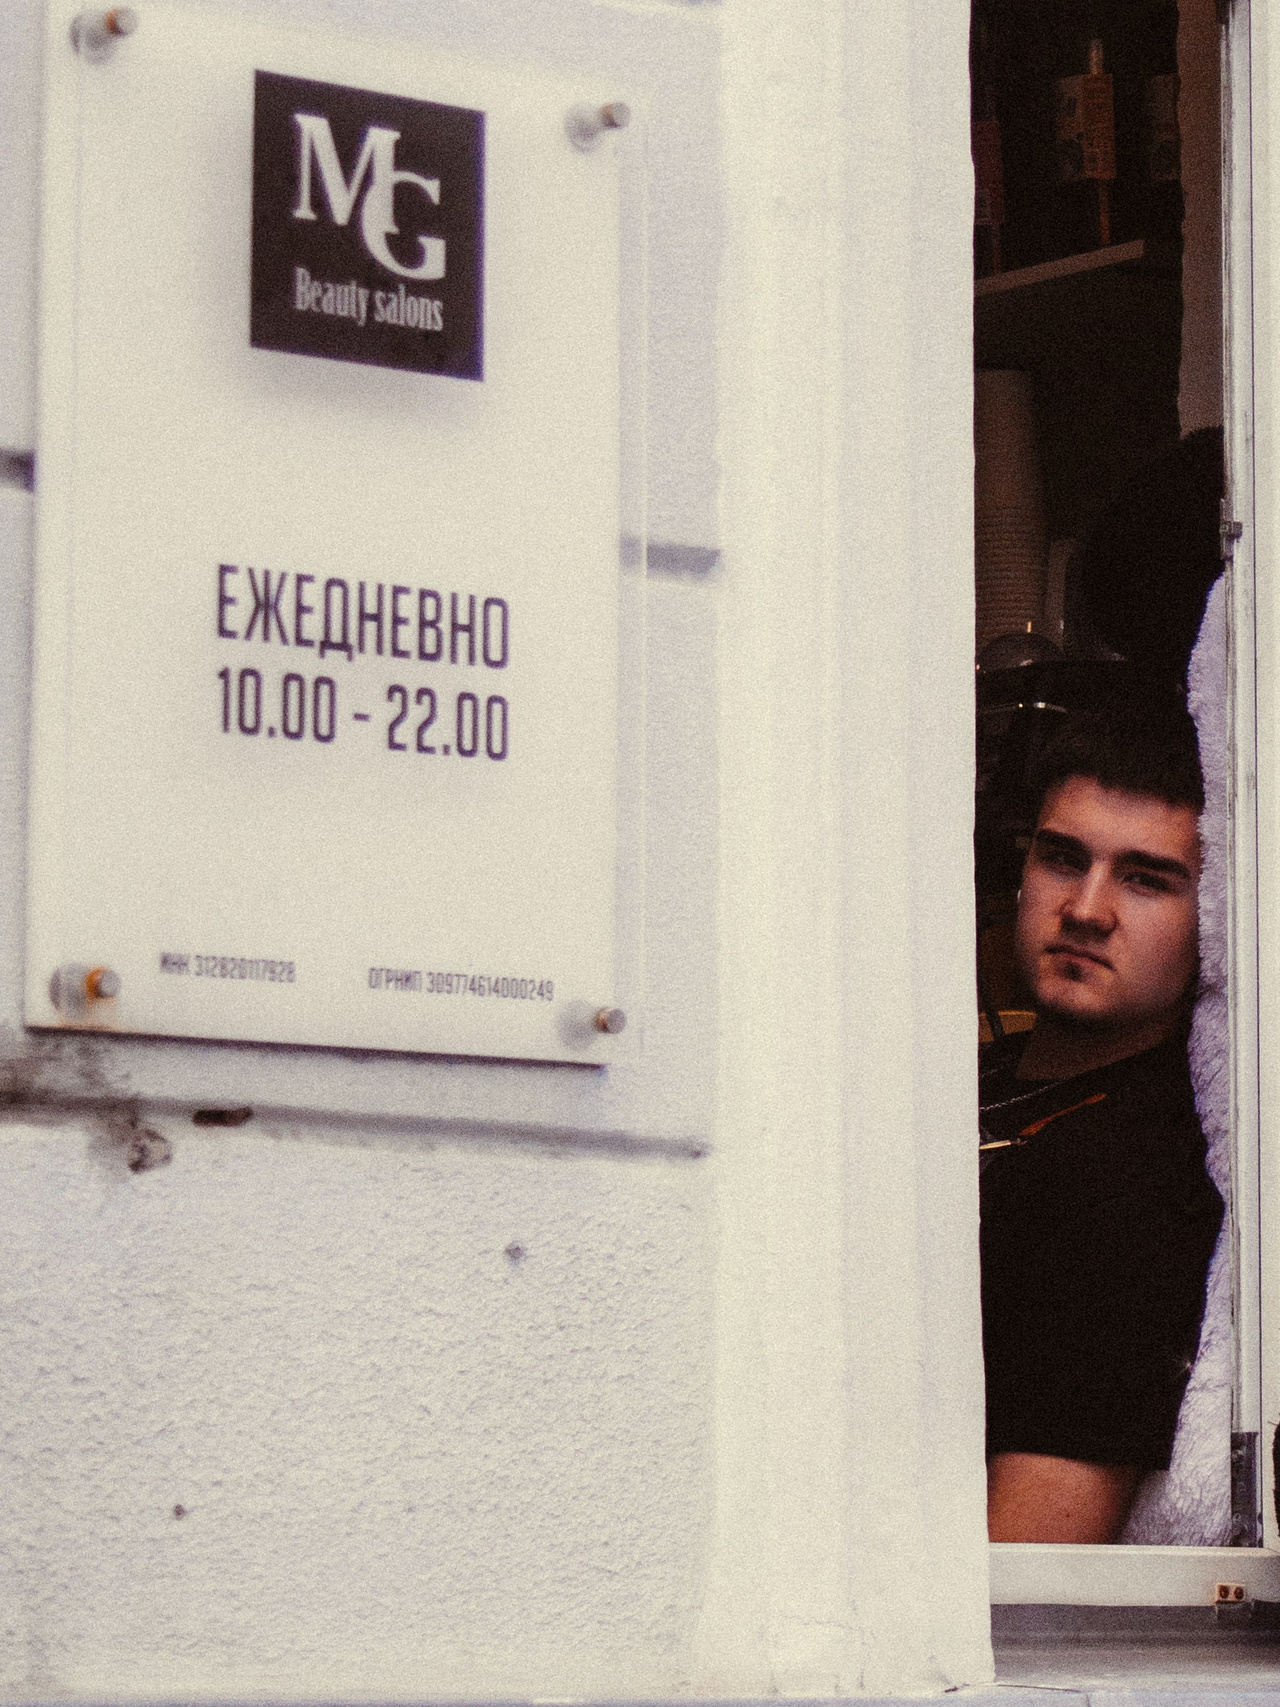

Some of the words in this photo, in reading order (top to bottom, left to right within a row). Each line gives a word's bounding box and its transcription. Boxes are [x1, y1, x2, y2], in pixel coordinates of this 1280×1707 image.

[292, 113, 446, 280] MG
[295, 266, 369, 327] Beauty
[374, 283, 444, 332] salons
[217, 563, 509, 669] ЕЖЕДНЕВНО
[217, 667, 336, 743] 10.00
[387, 684, 509, 761] 22.00
[368, 967, 423, 992] ОГРНИП
[426, 971, 555, 1001] 309774614000249
